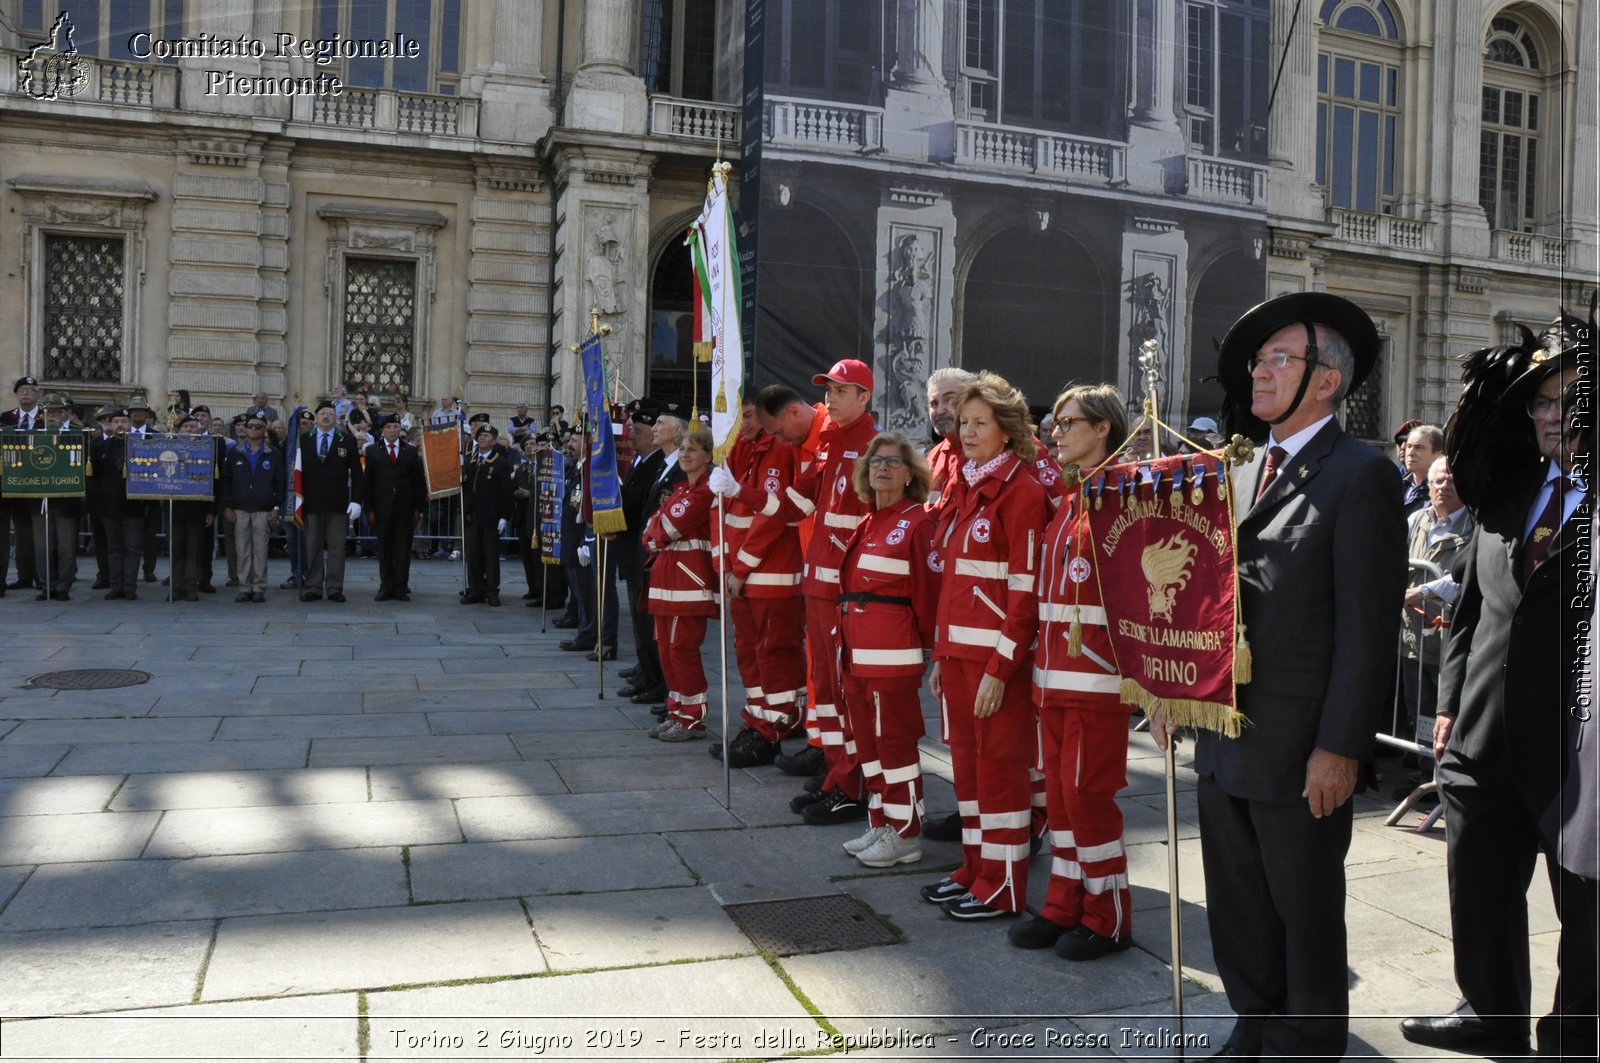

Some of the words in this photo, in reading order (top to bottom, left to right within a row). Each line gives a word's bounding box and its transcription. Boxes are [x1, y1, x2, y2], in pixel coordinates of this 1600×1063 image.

[7, 476, 40, 486] SEZIONE
[42, 476, 50, 485] DI
[51, 476, 80, 485] TORINO
[1141, 654, 1197, 686] TORINO
